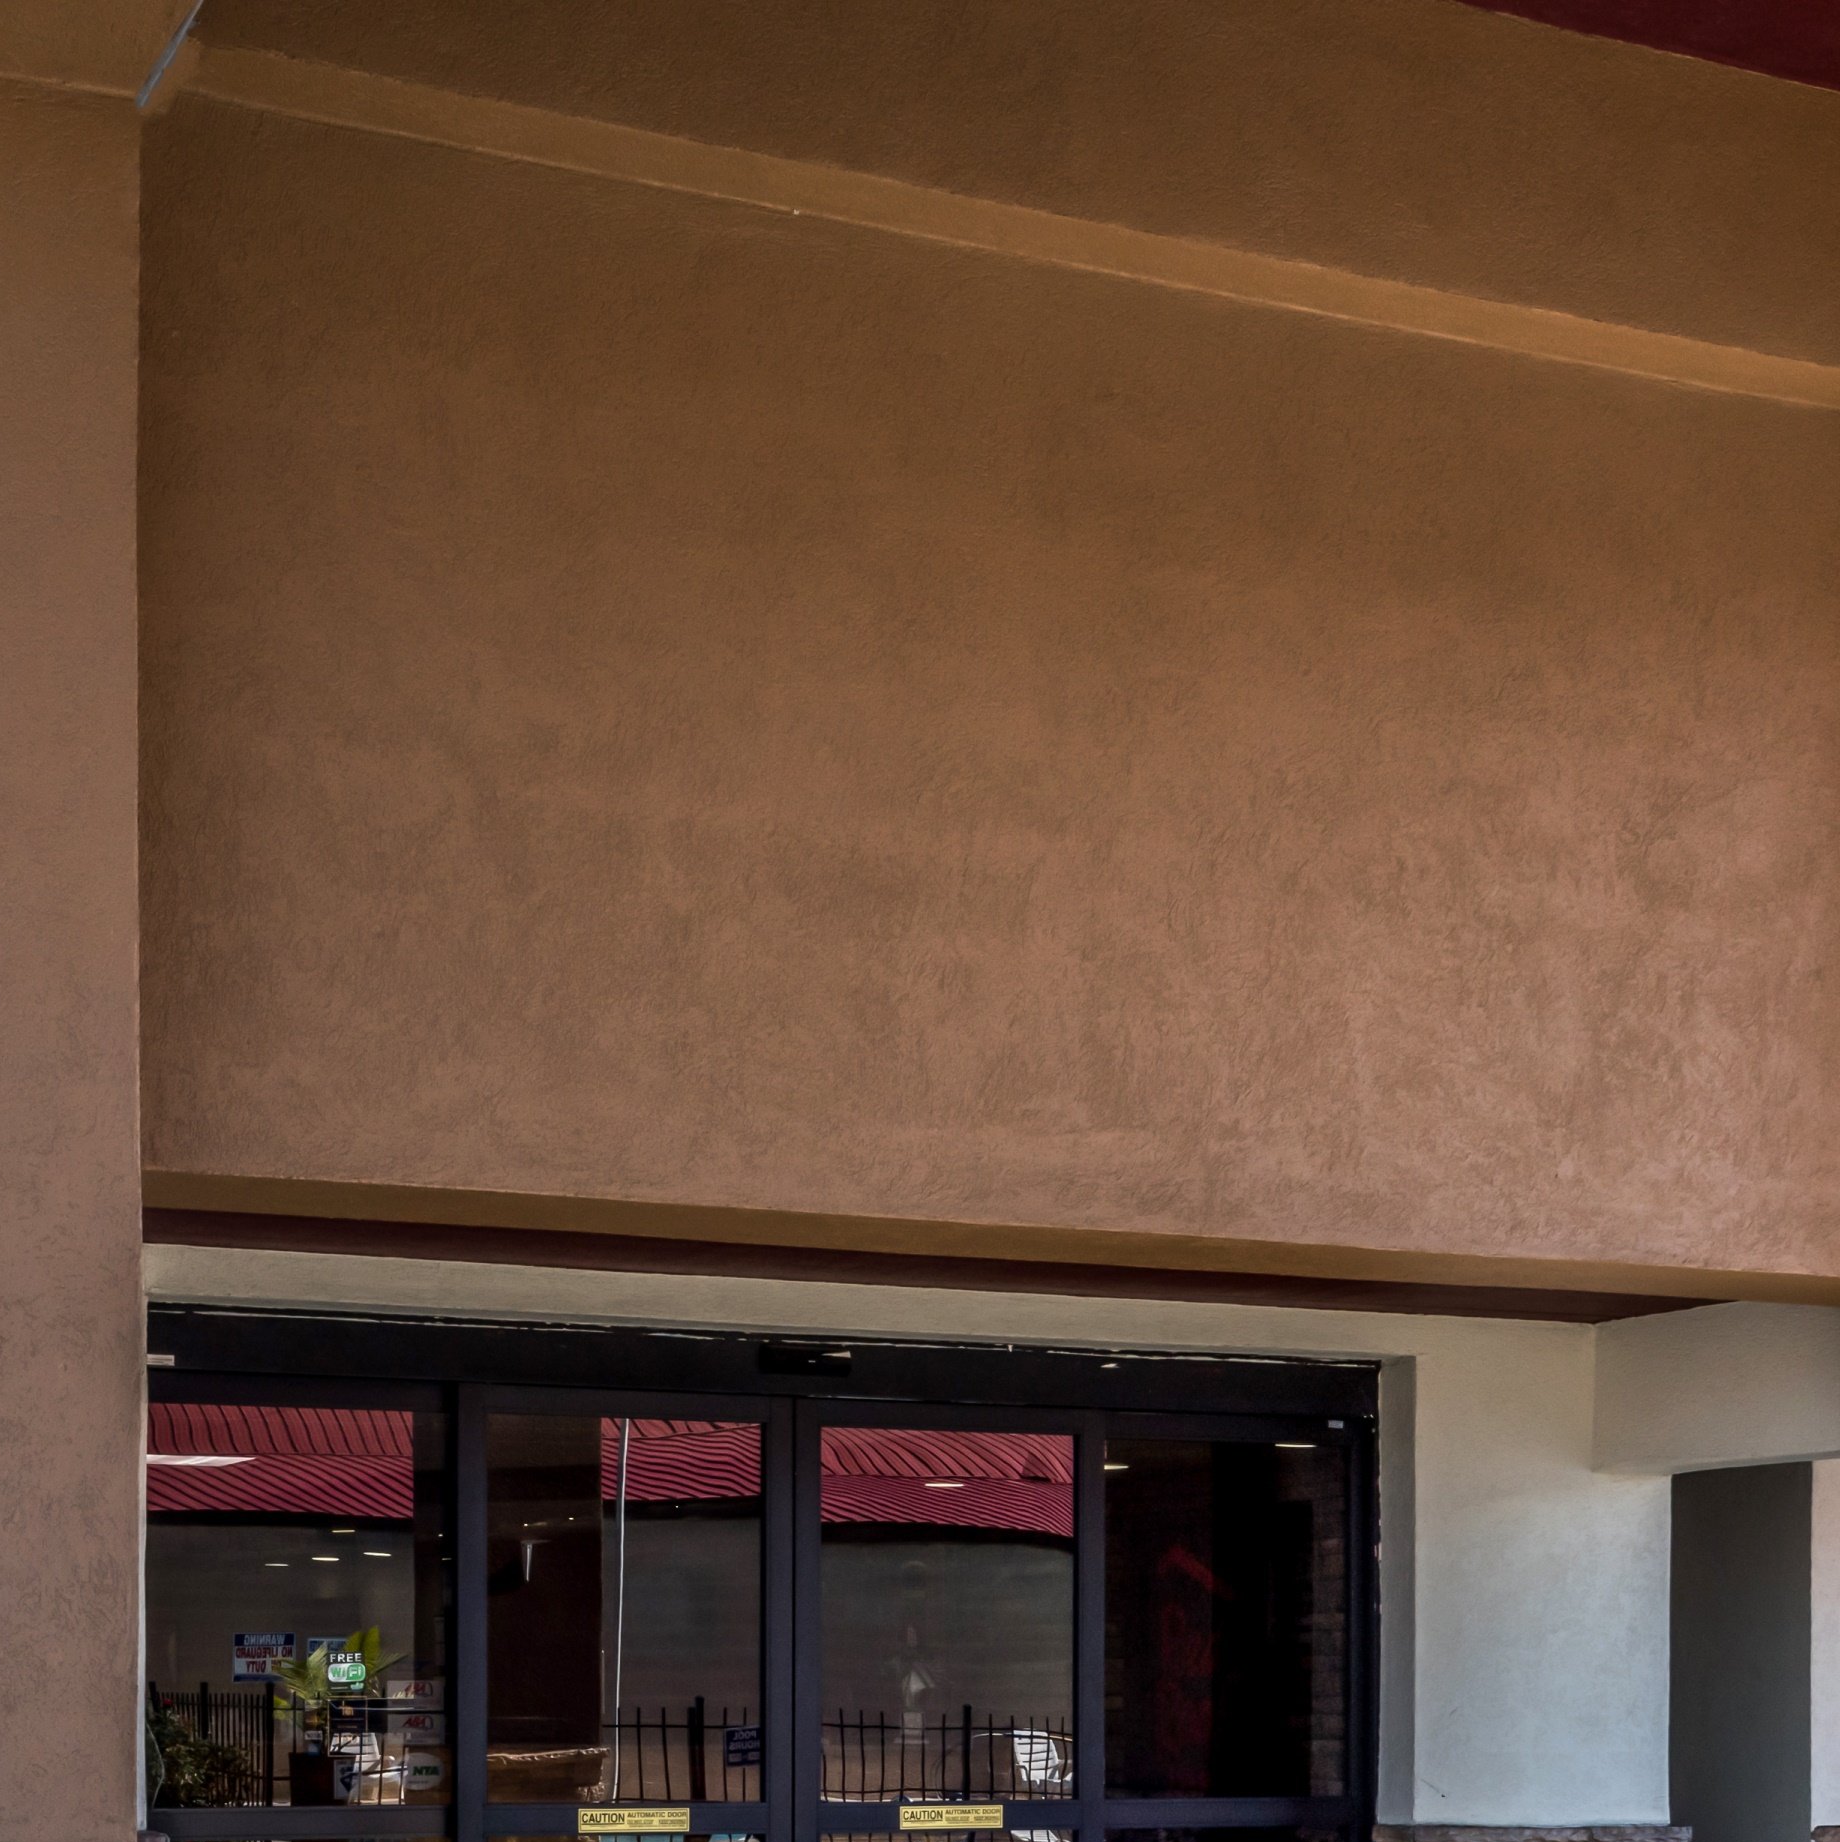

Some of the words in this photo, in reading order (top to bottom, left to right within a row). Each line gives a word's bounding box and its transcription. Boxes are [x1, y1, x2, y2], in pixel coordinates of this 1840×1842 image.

[329, 1653, 362, 1663] FREE
[581, 1812, 625, 1824] CAUTION
[627, 1811, 666, 1819] AUTOMATIC
[903, 1809, 944, 1821] CAUTION
[945, 1808, 981, 1816] AUTOMATIC
